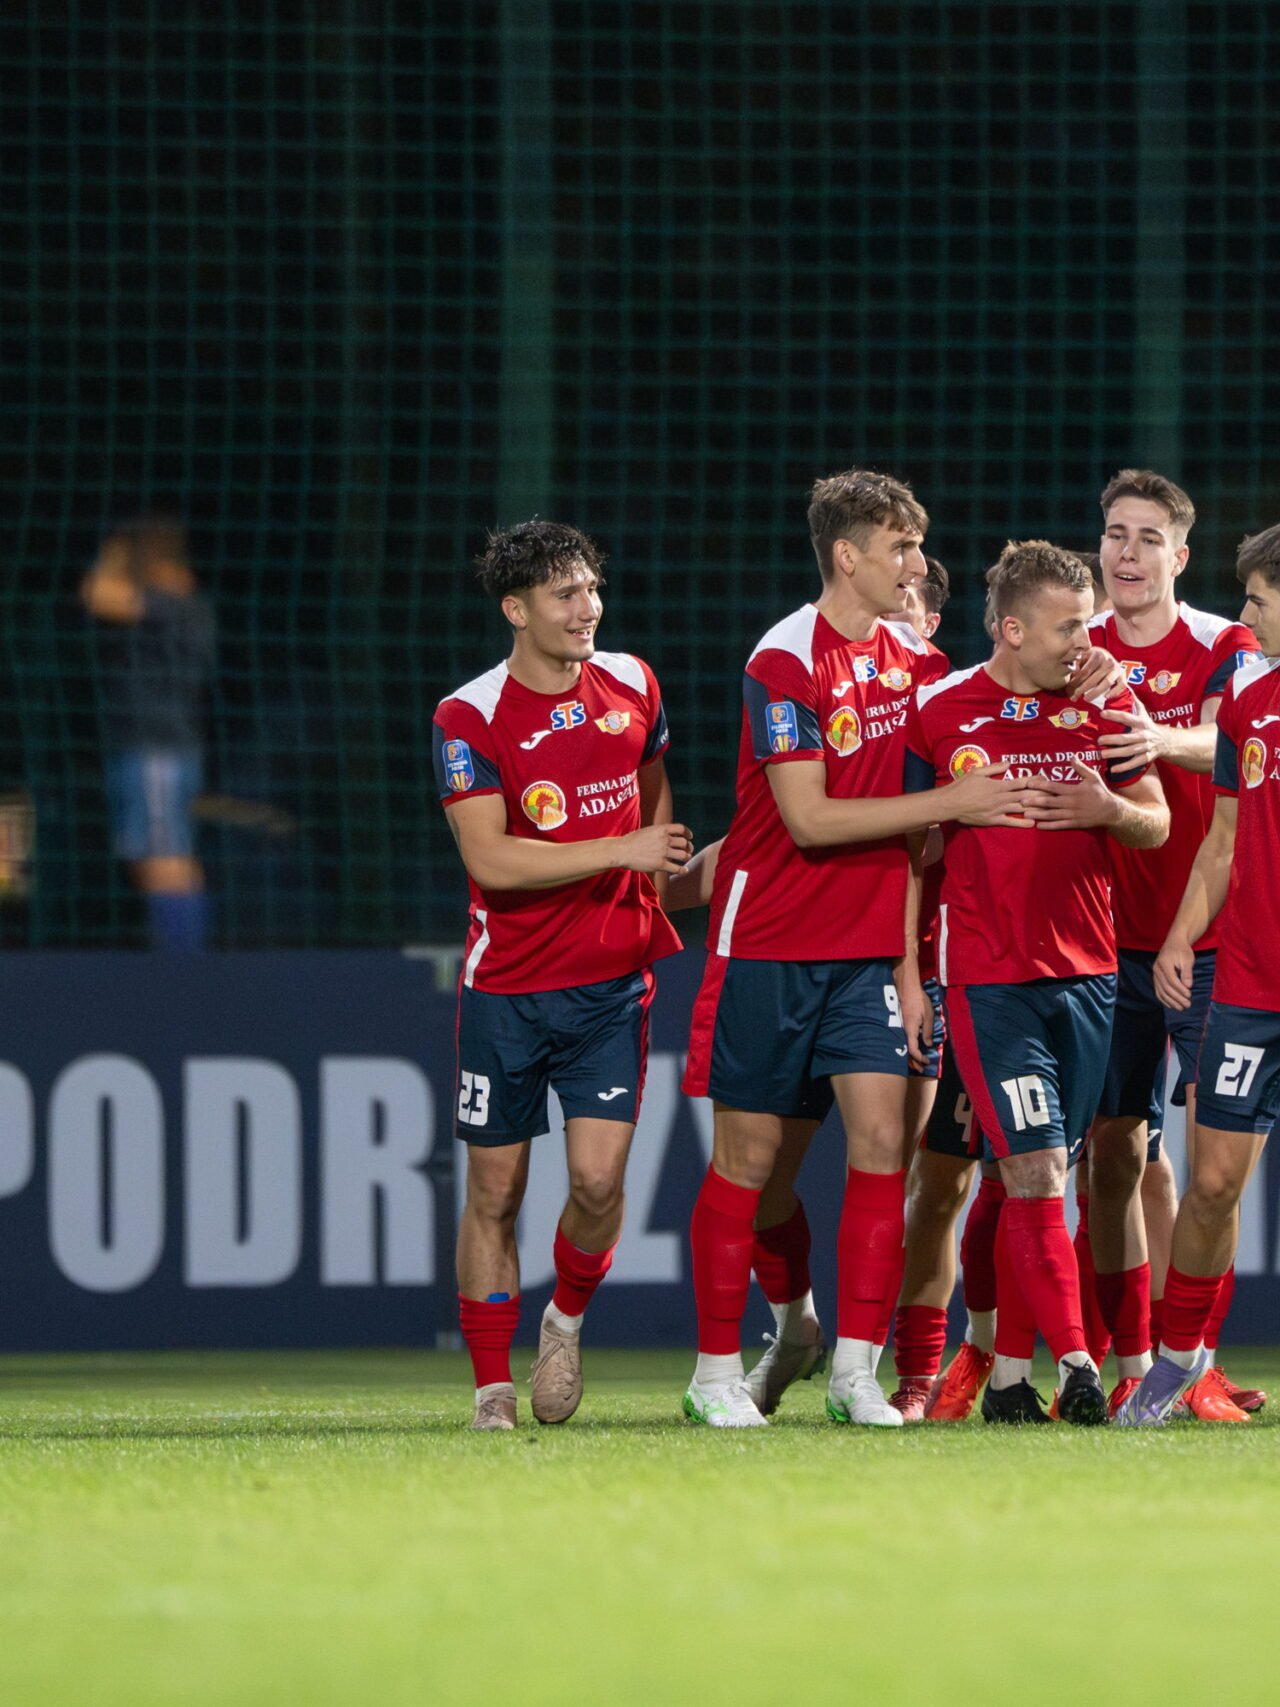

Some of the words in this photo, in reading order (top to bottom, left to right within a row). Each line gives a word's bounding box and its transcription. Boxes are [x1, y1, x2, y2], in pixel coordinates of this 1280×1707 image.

[1120, 660, 1147, 685] TS
[551, 700, 586, 730] STS
[1000, 696, 1040, 721] STS
[1001, 754, 1052, 765] FERMA
[576, 779, 619, 797] FERMA
[1214, 1042, 1266, 1097] 27
[458, 1069, 491, 1126] 23
[1001, 1074, 1051, 1132] 10
